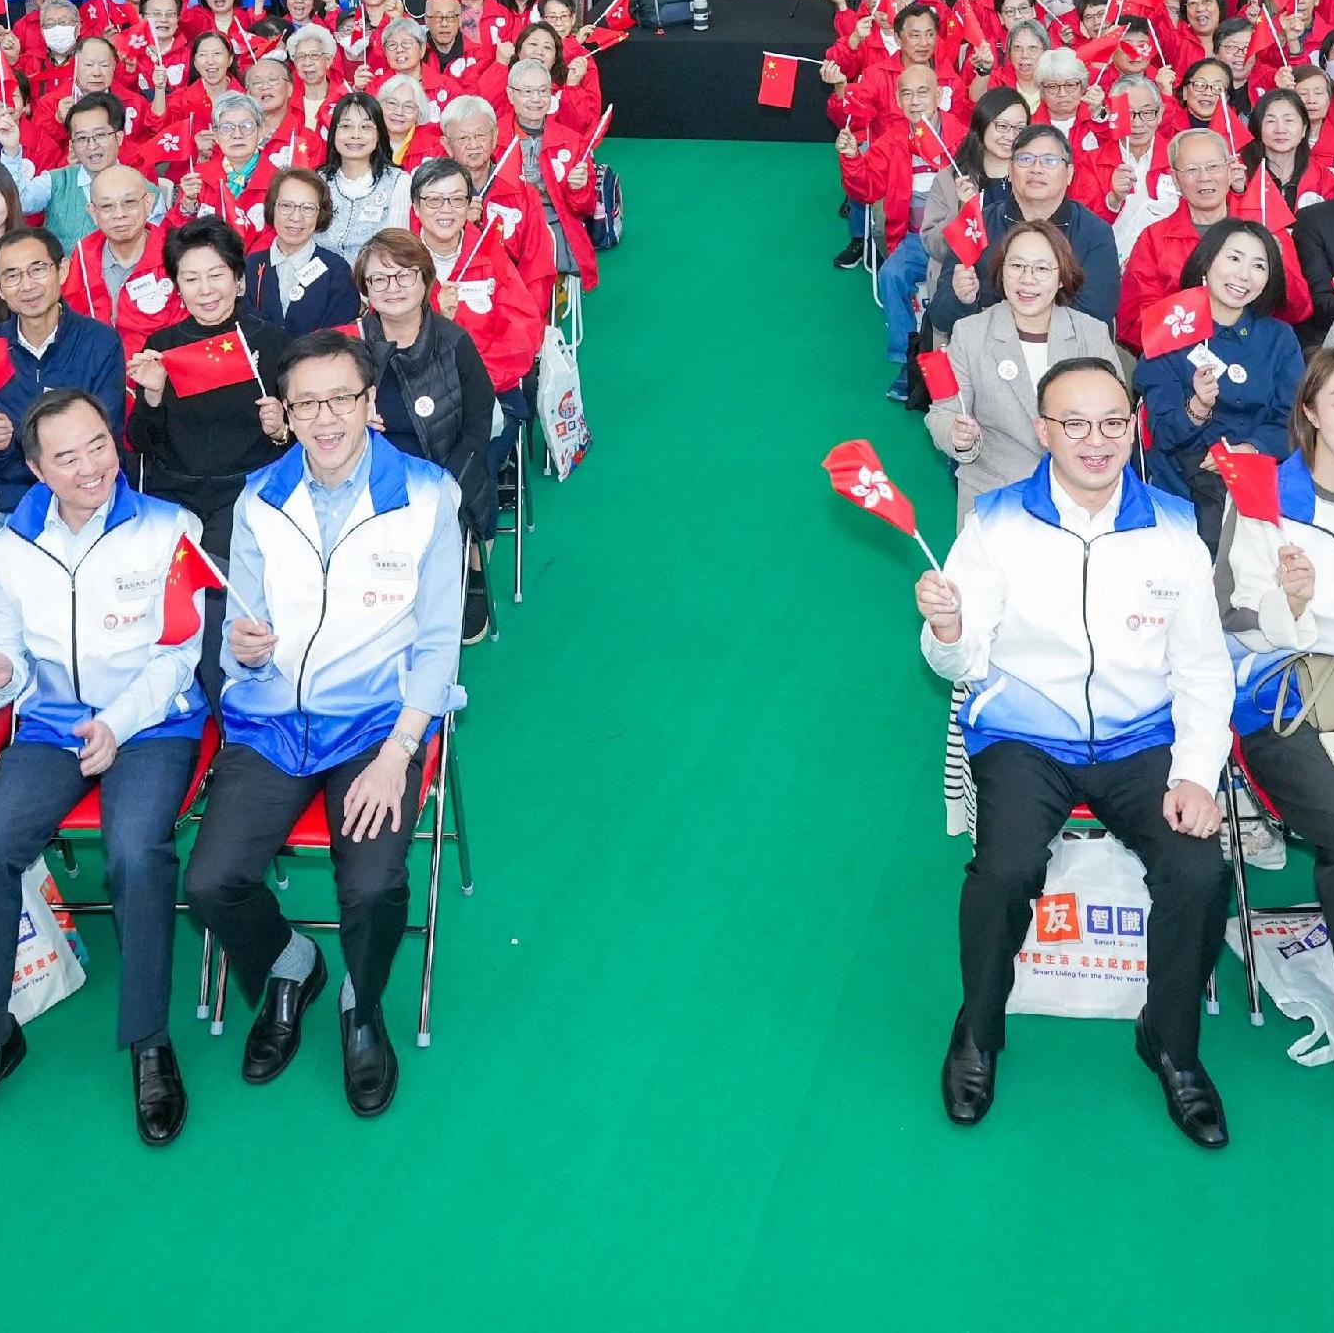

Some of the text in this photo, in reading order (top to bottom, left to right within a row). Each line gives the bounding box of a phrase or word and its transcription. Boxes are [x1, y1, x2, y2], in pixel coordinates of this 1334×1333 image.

[1042, 900, 1141, 935] 友智識
[1093, 938, 1116, 947] Smart
[1018, 951, 1070, 966] 智慧生活
[1032, 968, 1147, 984] Smart Living for the Silver Years
